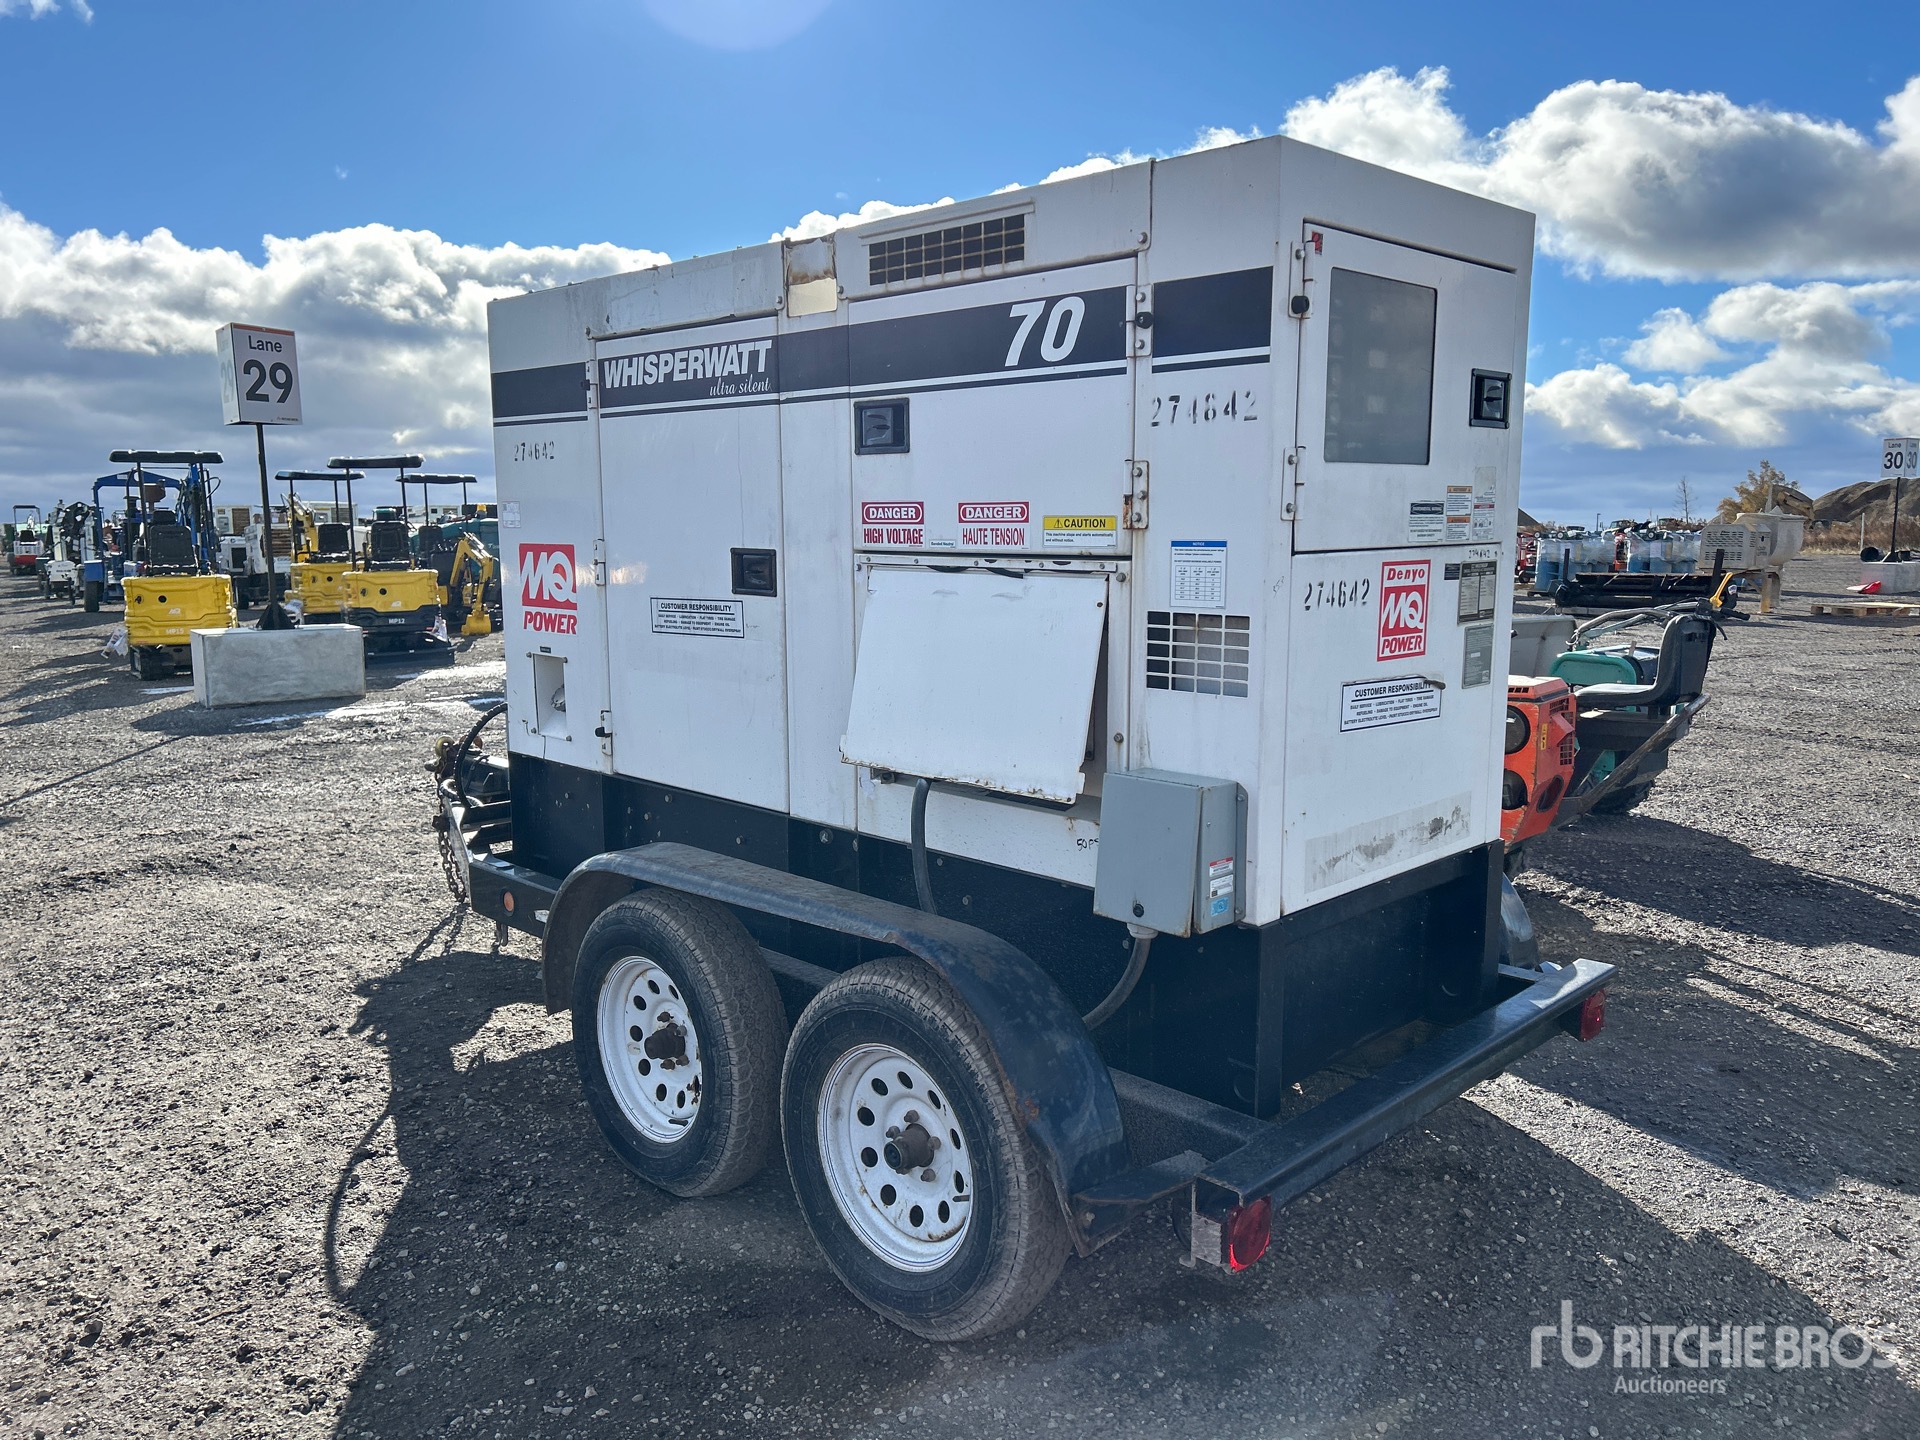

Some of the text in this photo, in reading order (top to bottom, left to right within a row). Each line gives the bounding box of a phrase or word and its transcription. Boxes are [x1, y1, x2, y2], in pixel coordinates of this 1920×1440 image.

[1005, 296, 1085, 367] 70
[248, 335, 283, 353] Lane
[604, 340, 772, 389] WHISPERWATT
[243, 359, 293, 404] 29
[709, 374, 773, 396] ultra silent
[1151, 390, 1258, 427] 274642
[514, 441, 555, 462] 274642
[1884, 452, 1903, 469] 30
[869, 507, 916, 519] DANGER
[965, 506, 1022, 519] DANGER
[1063, 518, 1106, 528] CAUTION
[863, 528, 924, 545] HIGH VOLTAGE
[963, 527, 1025, 546] HAUTE TENSION
[520, 550, 577, 604] MQ
[1387, 567, 1425, 583] Denyo
[1304, 578, 1370, 611] 274642
[660, 602, 732, 612] CUSTOMER RESPONSIBILITY
[1381, 590, 1424, 630] MQ
[523, 611, 578, 636] POWER
[1381, 635, 1423, 655] POWER
[1354, 686, 1387, 698] CUSTOMER
